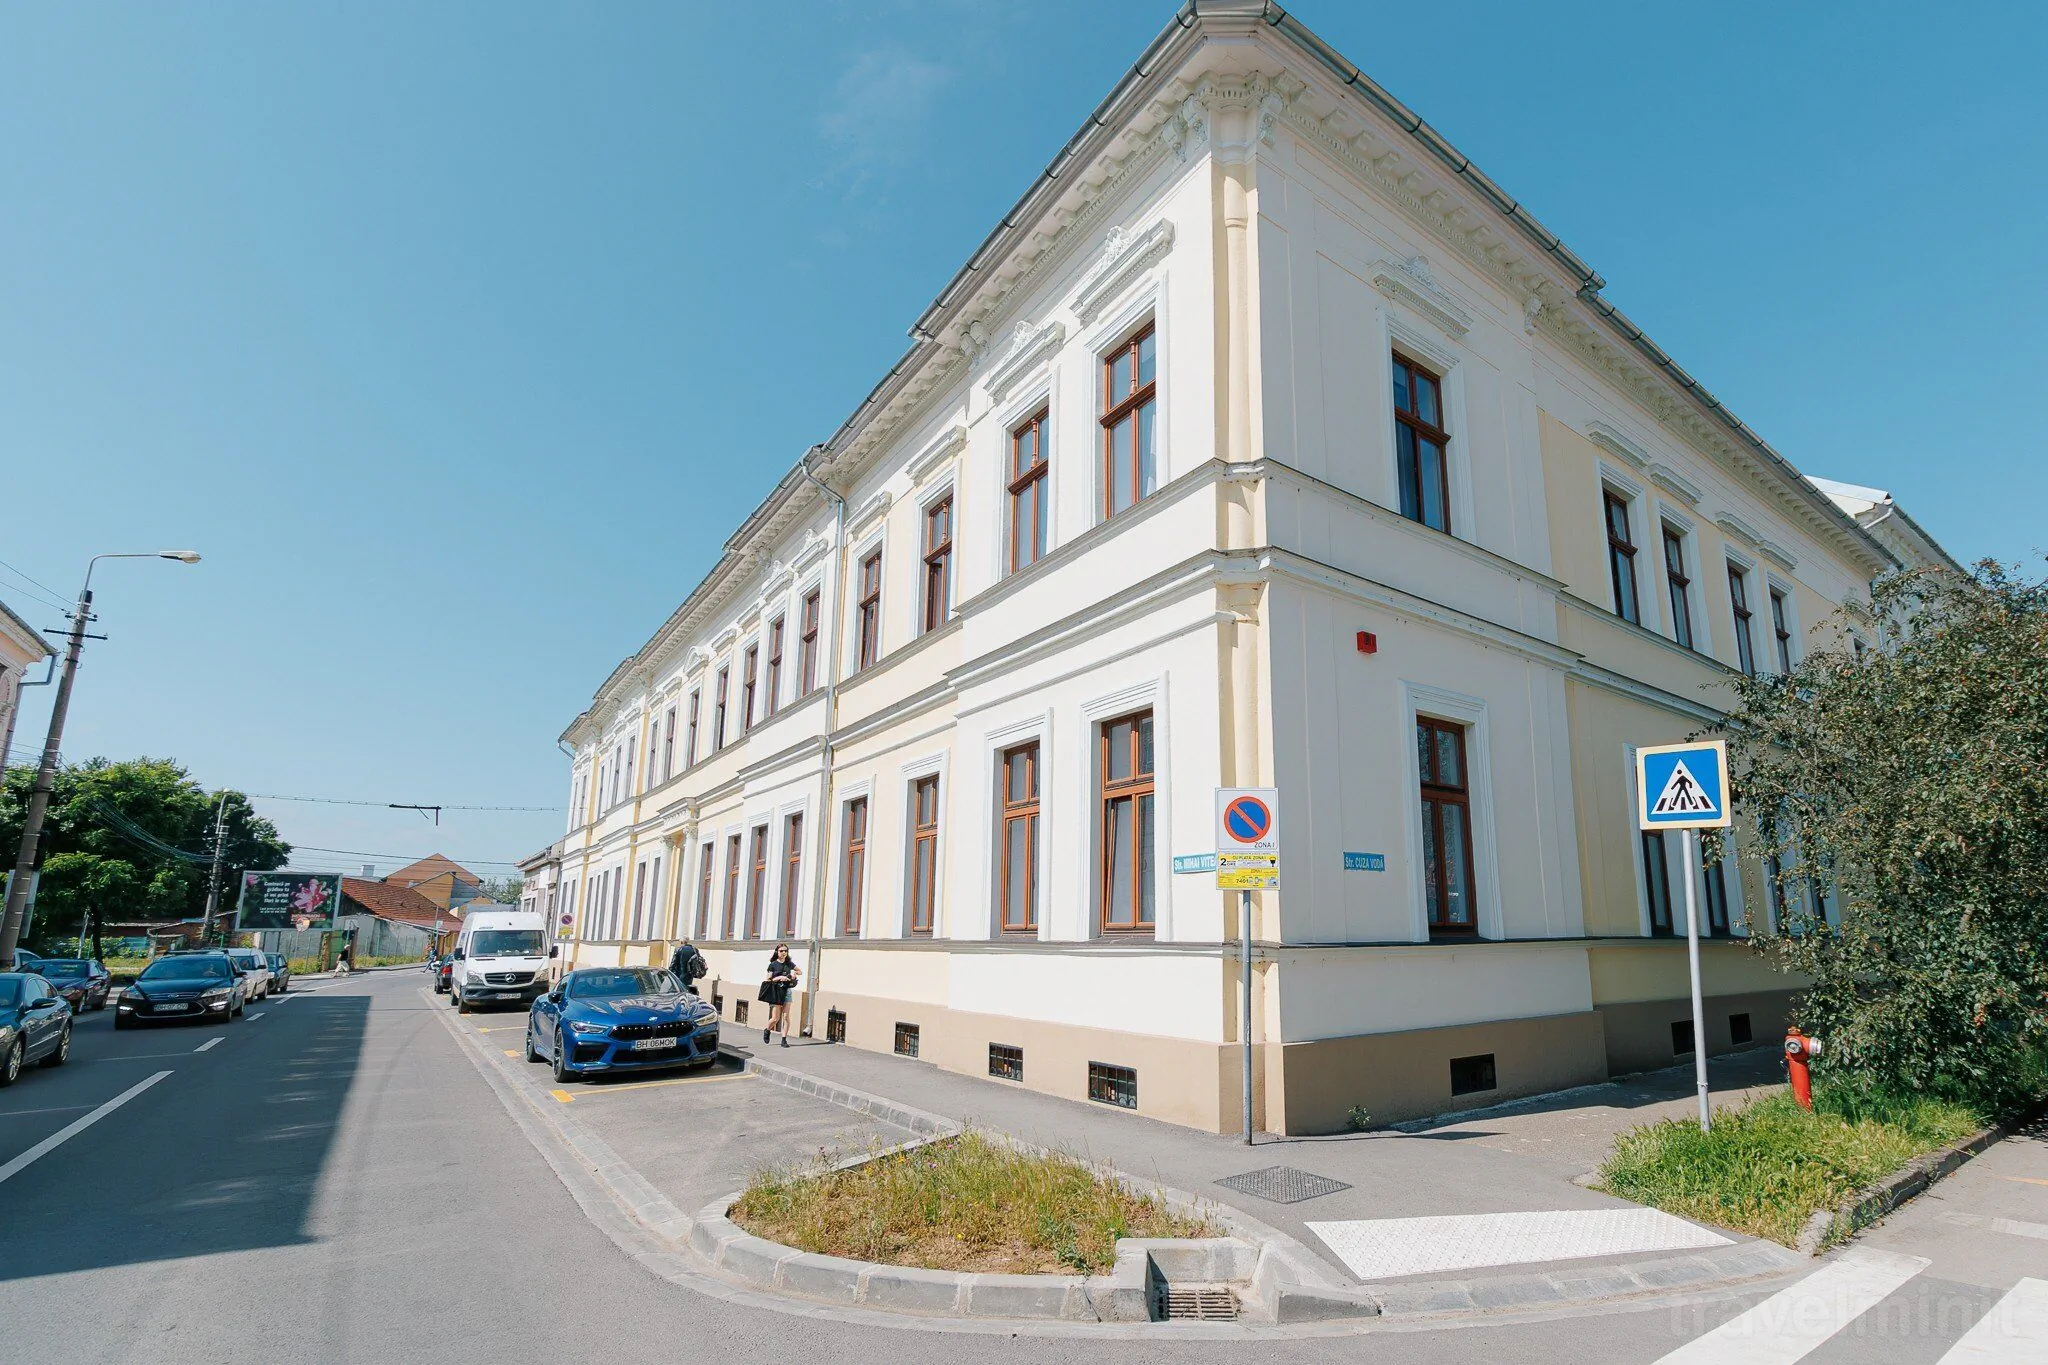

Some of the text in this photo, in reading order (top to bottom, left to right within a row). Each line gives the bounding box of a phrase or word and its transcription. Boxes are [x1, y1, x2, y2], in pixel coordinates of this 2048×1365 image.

[1220, 858, 1227, 866] 2
[1355, 857, 1369, 869] CUZA
[636, 1040, 648, 1048] BH
